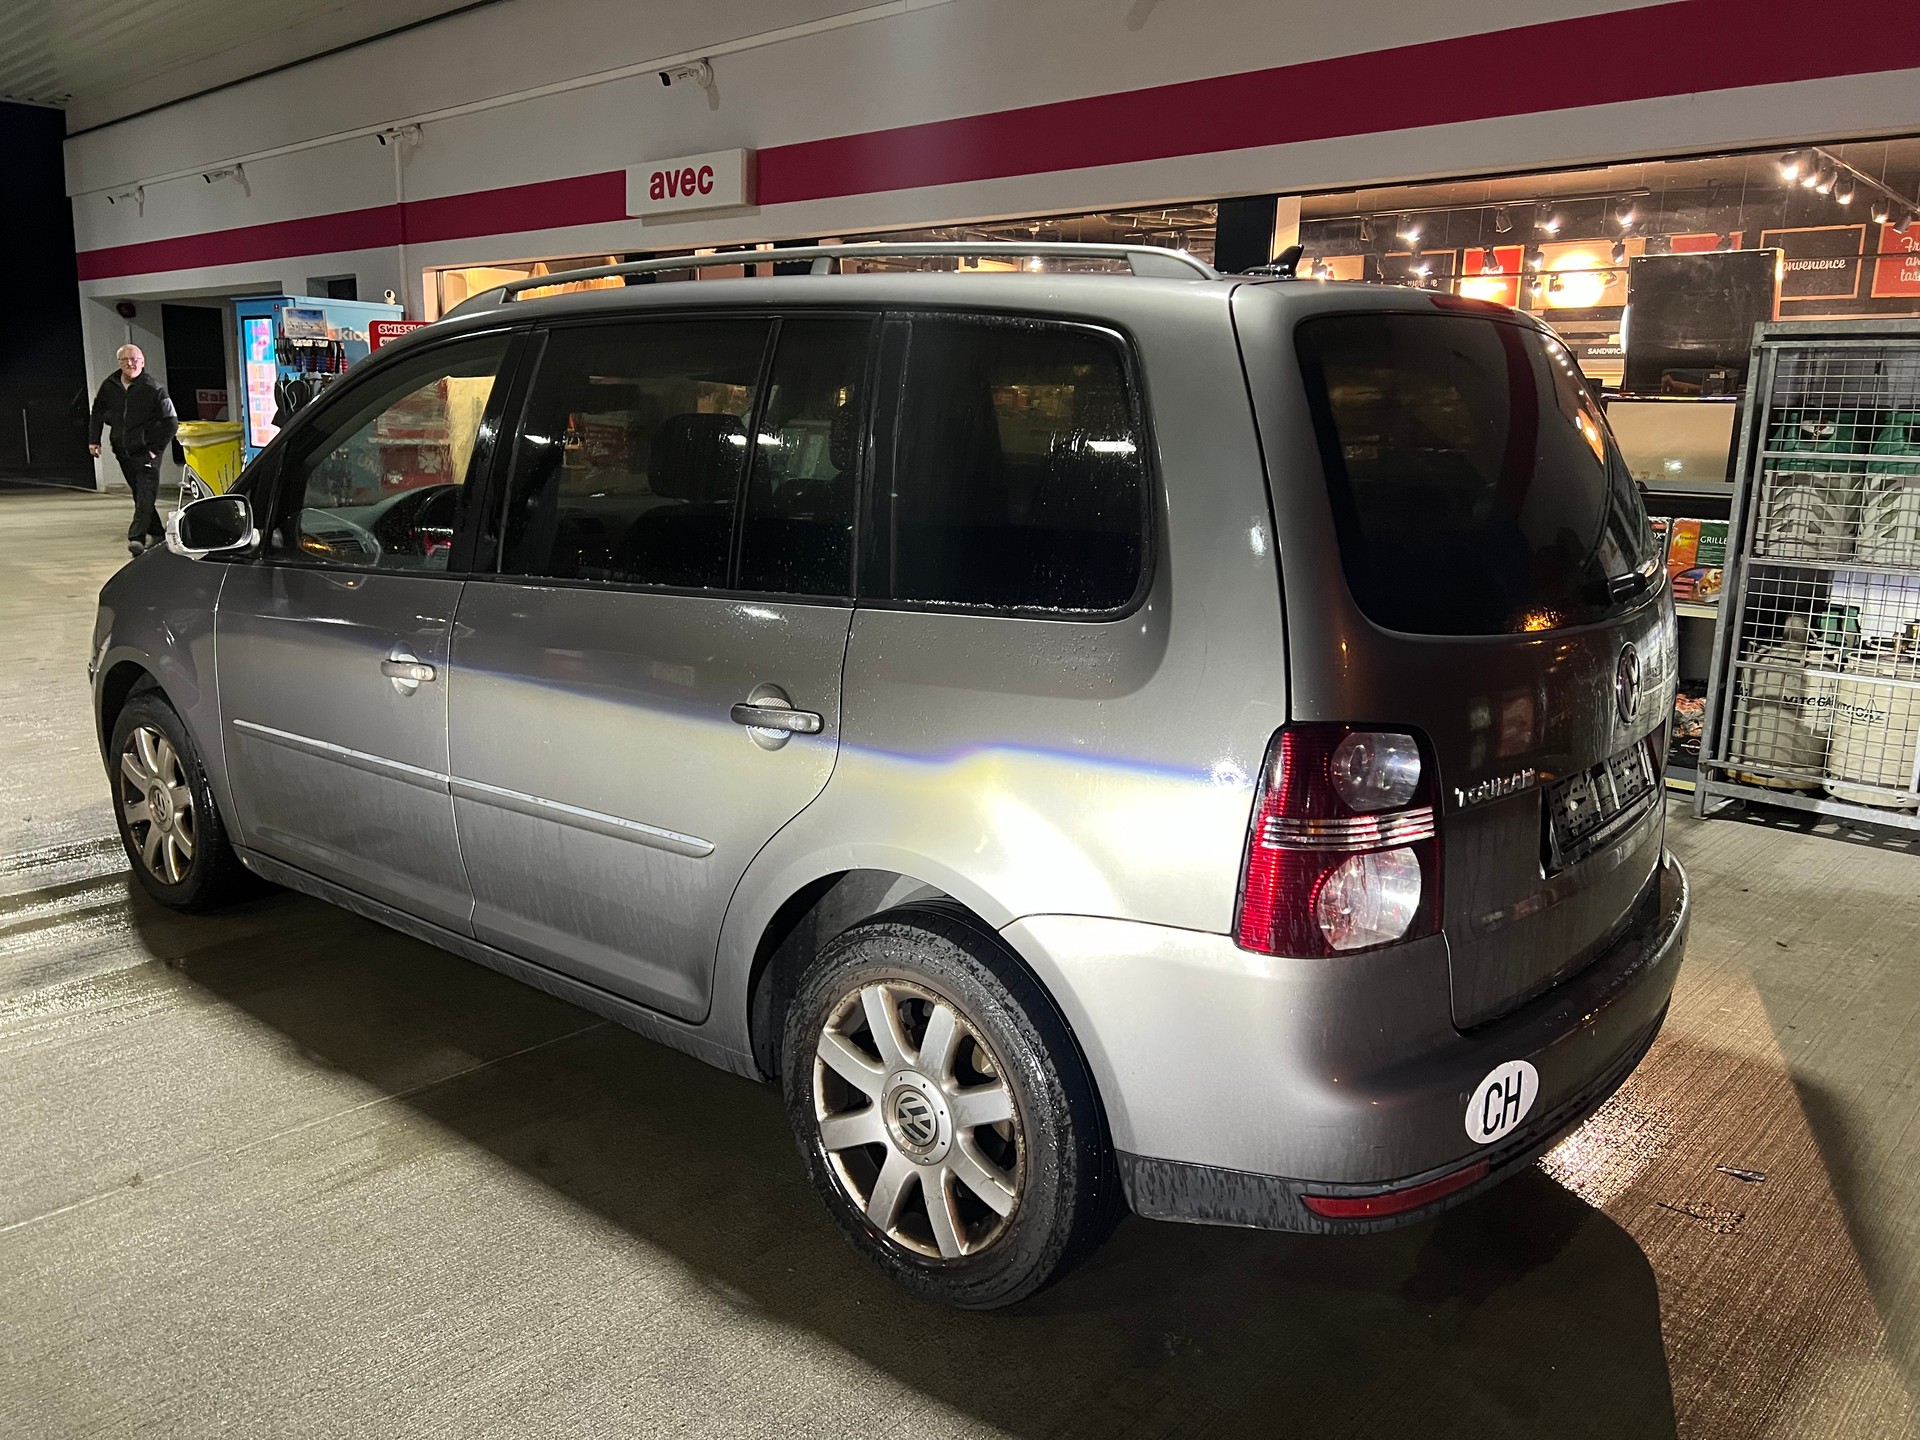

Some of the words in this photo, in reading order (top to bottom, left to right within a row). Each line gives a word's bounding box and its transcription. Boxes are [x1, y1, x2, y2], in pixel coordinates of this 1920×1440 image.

[649, 165, 714, 201] avec
[1782, 258, 1846, 272] onvenience
[378, 323, 424, 335] SWISS
[1483, 1070, 1523, 1136] CH
